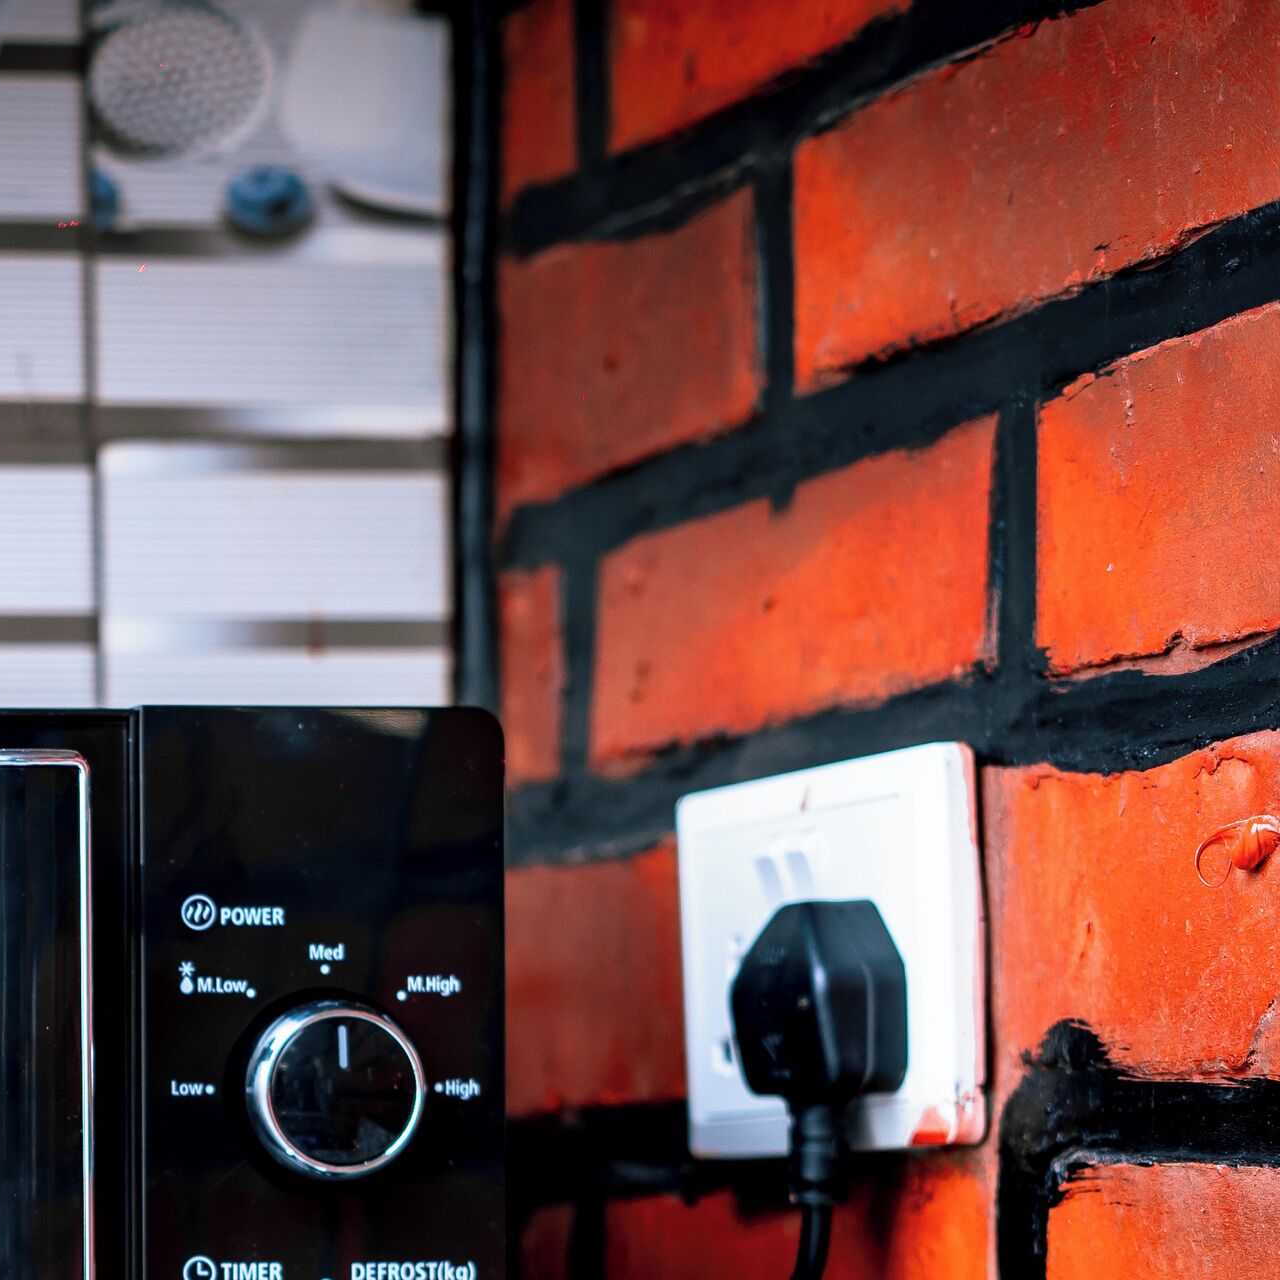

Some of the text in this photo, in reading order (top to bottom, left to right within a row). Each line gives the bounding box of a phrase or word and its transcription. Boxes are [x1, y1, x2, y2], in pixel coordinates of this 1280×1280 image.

[220, 907, 285, 926] POWER
[309, 943, 344, 961] Med
[197, 977, 248, 993] M.Low
[407, 974, 461, 997] M.High
[171, 1080, 204, 1096] Low
[445, 1078, 480, 1100] High
